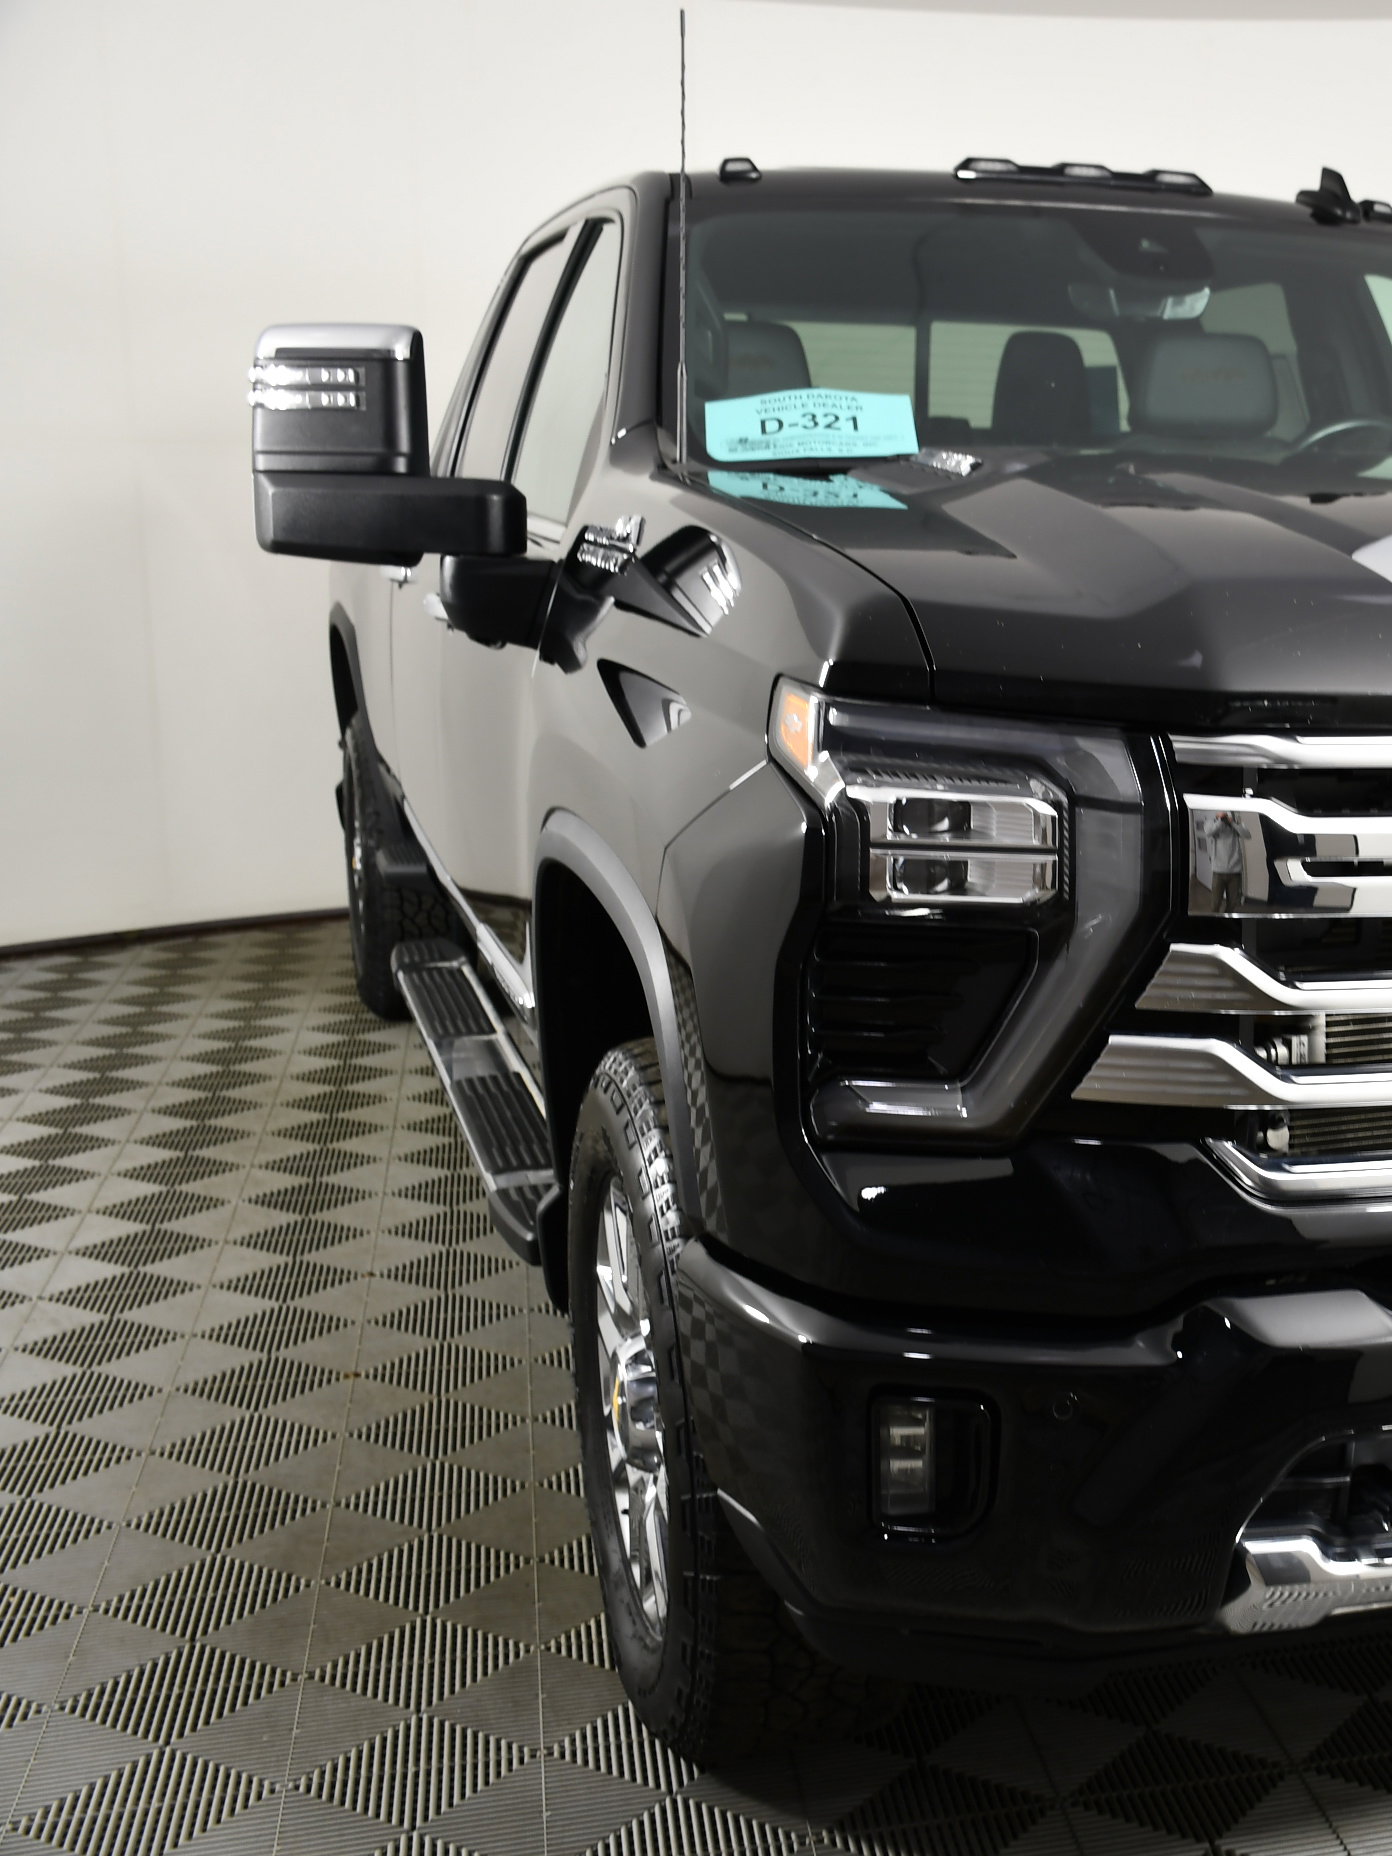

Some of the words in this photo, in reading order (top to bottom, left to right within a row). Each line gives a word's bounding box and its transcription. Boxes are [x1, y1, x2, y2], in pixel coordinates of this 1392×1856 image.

[760, 393, 801, 405] SOUTH
[806, 393, 859, 404] DAKOTA
[755, 402, 809, 415] VEHICLE
[813, 401, 864, 412] DEALER
[760, 412, 859, 436] D-321
